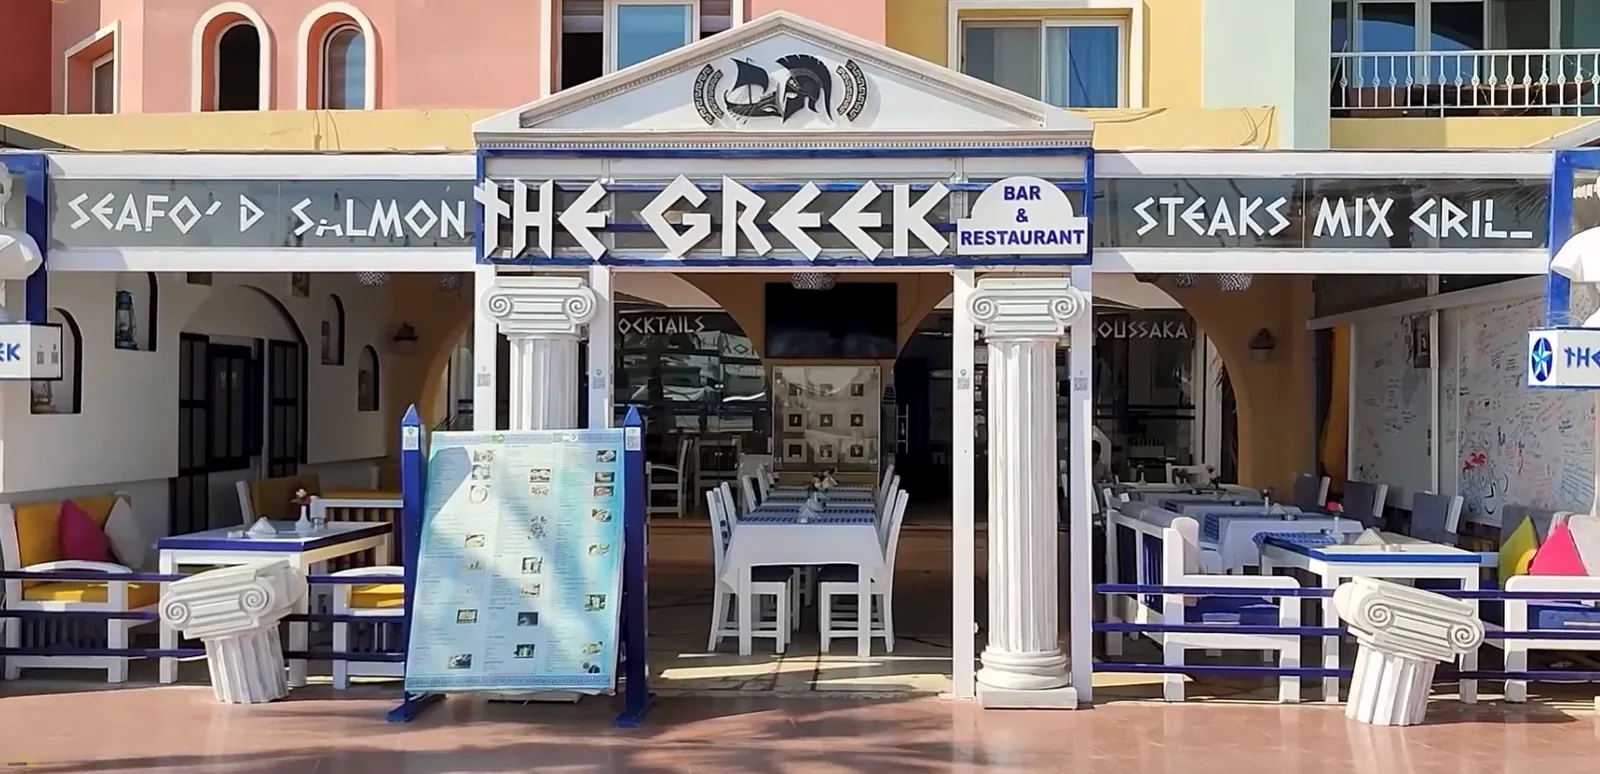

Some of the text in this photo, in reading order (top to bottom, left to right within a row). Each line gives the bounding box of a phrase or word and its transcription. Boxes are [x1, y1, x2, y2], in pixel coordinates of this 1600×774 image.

[67, 192, 265, 235] SEAFOD
[1003, 185, 1042, 201] BAR
[474, 174, 950, 262] THE GREEK
[1015, 208, 1029, 223] &
[1133, 196, 1291, 237] STEAKS
[1312, 197, 1395, 238] MIX
[960, 229, 1085, 246] RESTAURANT
